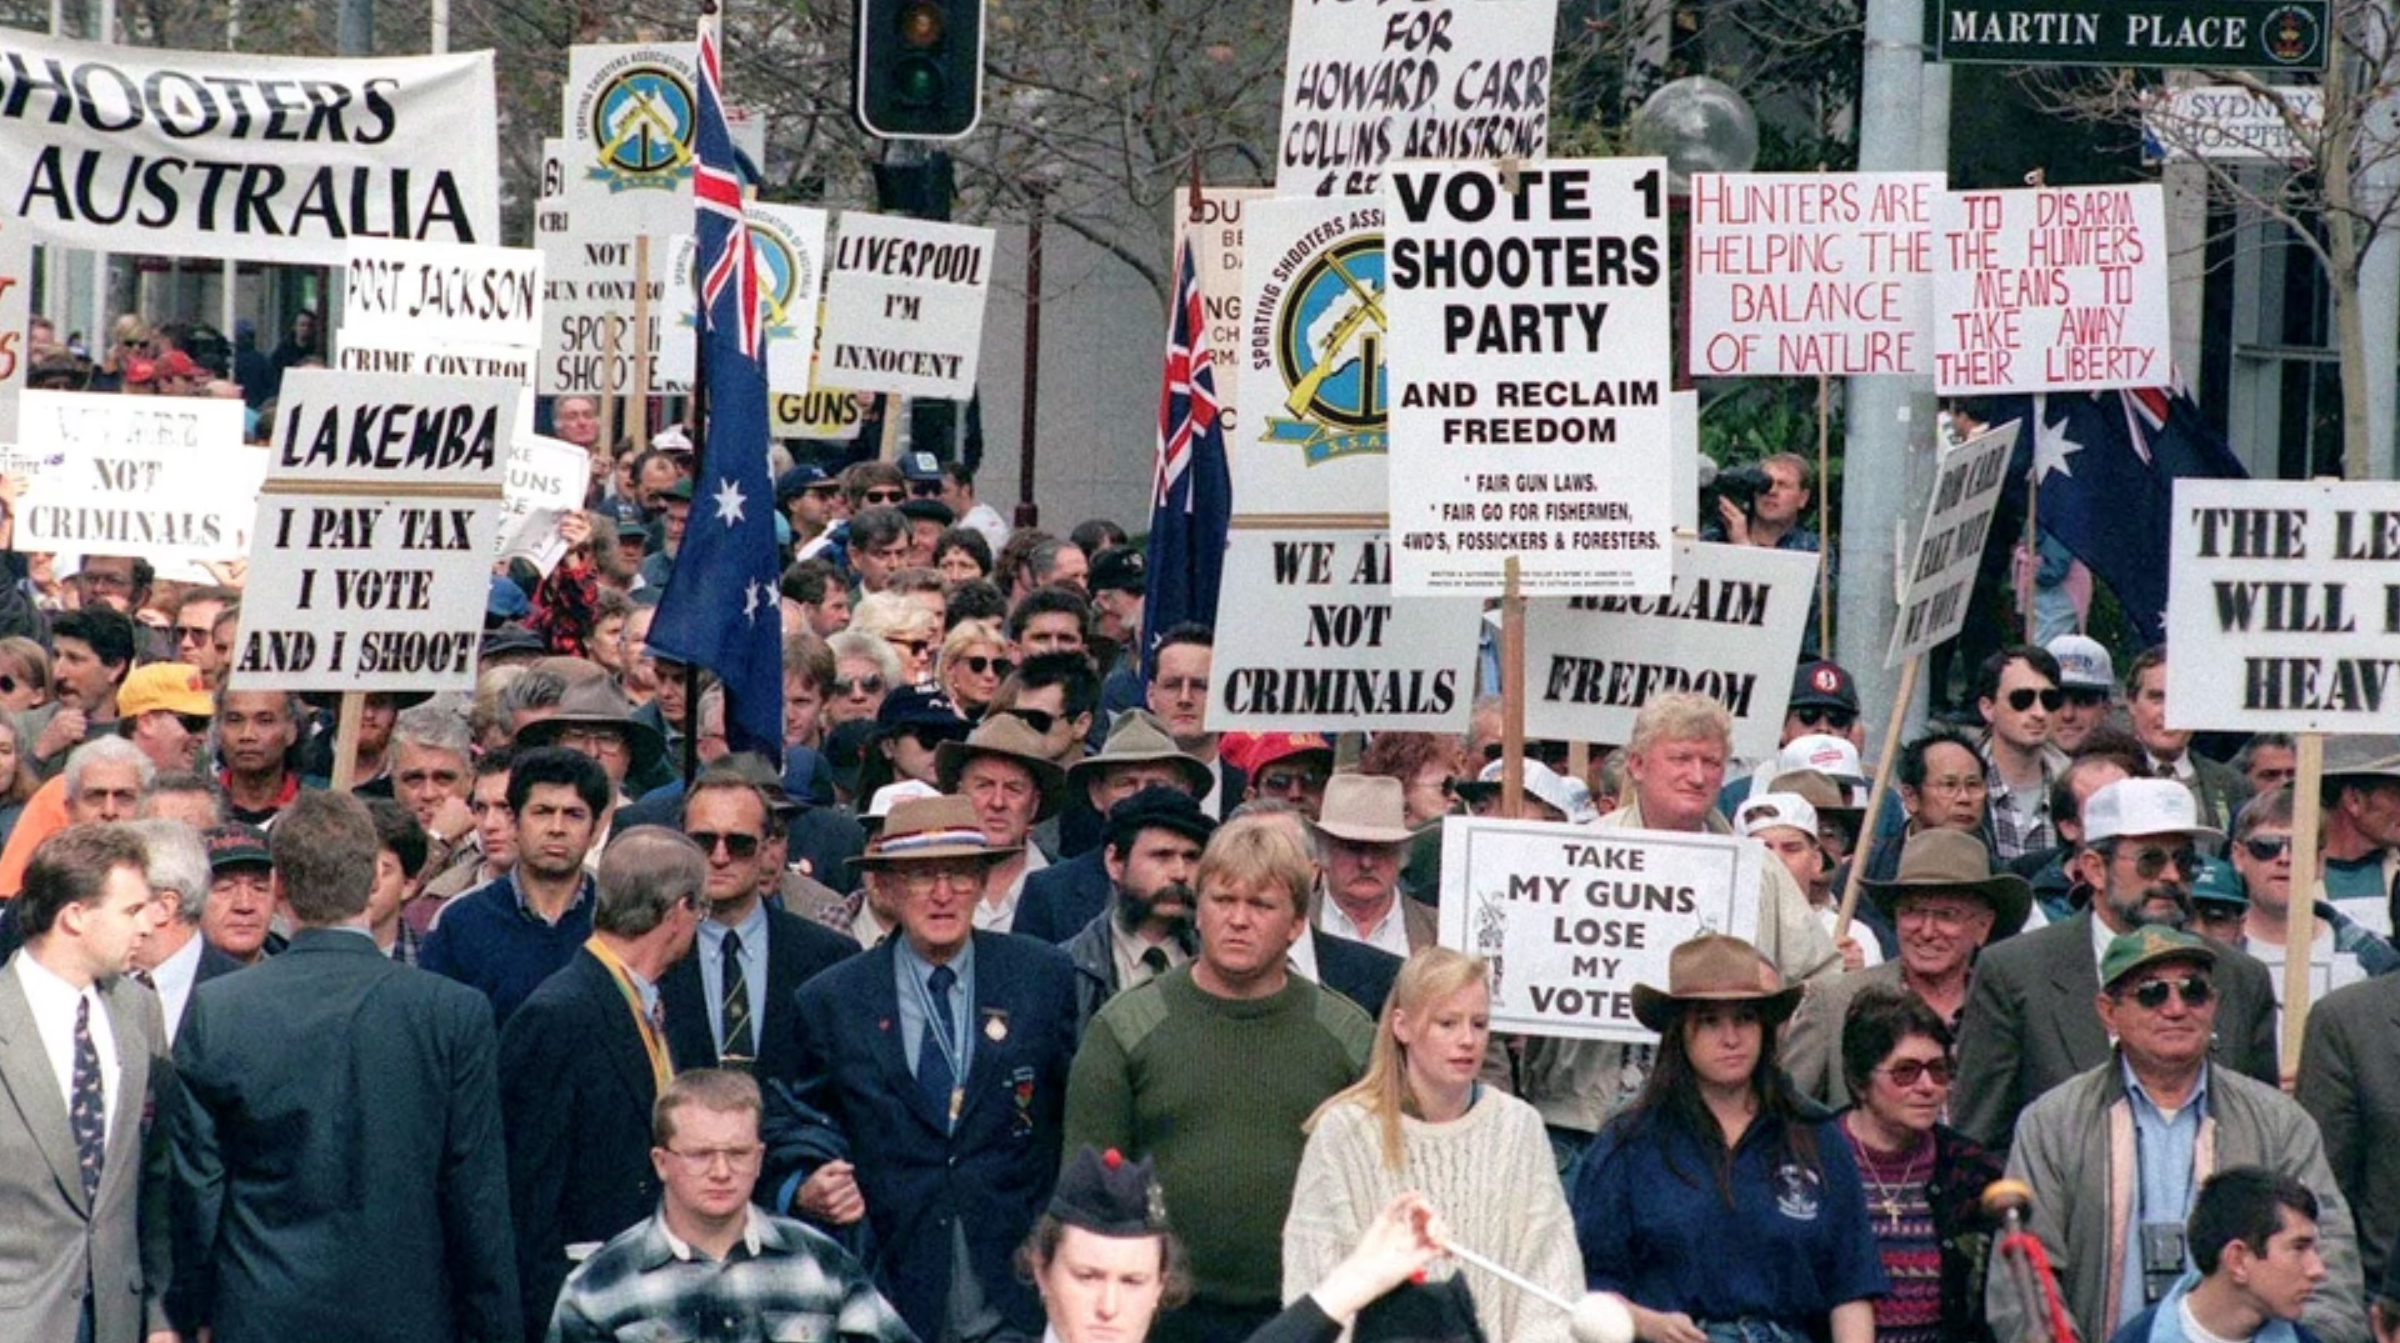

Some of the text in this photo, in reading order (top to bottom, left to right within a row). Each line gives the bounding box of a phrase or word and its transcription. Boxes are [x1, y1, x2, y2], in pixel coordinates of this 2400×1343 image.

[1383, 9, 1453, 52] FOR
[1950, 10, 2247, 48] MARTIN PLACE
[0, 53, 400, 144] HOOTERS
[1454, 56, 1547, 111] CARR
[2191, 94, 2314, 118] SYDNY
[1285, 114, 1544, 168] COLLINS ARMSTRONG
[18, 146, 476, 244] AUSTRALIA
[1392, 171, 1592, 223] VOTE
[1633, 170, 1660, 219] 1
[1697, 175, 1930, 225] HUNTERS ARE
[1963, 191, 2135, 230] TO DISARM
[585, 243, 629, 266] NOT
[837, 236, 983, 286] LIVERPOOL
[1392, 235, 1660, 289] SHOOTERS
[1697, 231, 1933, 274] HELPING THE
[1945, 227, 2144, 271] THE HUNTERS
[349, 258, 540, 322] PORT JACKSON
[884, 294, 921, 320] I'M
[1251, 283, 1281, 371] SPORTING
[1274, 216, 1347, 281] SHOOTERS
[1731, 281, 1902, 322] BALANCE
[1974, 266, 2133, 310] MEANS TO
[1444, 303, 1608, 353] PARTY
[1952, 306, 2125, 350] TAKE AWAY
[834, 344, 963, 380] INNOCENT
[1707, 331, 1915, 373] OF NATURE
[1936, 346, 2155, 386] THEIR LIBERTY
[778, 391, 859, 425] GUNS
[1401, 381, 1659, 408] AND RECLAIM
[1443, 418, 1616, 444] FREEDOM
[92, 458, 163, 493] NOT
[1477, 474, 1598, 492] FAIR GUN LAWS.
[29, 505, 222, 547] CRIMINALS
[275, 508, 295, 549] I
[307, 508, 382, 550] PAY
[400, 509, 475, 551] TAX
[1443, 502, 1633, 523] FAIR GO FOR FISHERMEN,
[2192, 508, 2307, 559] THE
[1457, 532, 1548, 550] FOSSICKERS
[1555, 532, 1566, 550] &
[1572, 531, 1660, 550] FORESTERS.
[1273, 541, 1335, 585] WE
[297, 569, 434, 610] I VOTE
[2212, 581, 2355, 633] WILL
[1304, 604, 1391, 647] NOT
[237, 631, 475, 673] AND I SHOOT
[1224, 668, 1456, 716] CRIMINALS
[1562, 844, 1645, 872] TAKE
[1508, 874, 1696, 913] MY GUNS
[1554, 917, 1646, 949] LOSE
[1572, 956, 1621, 979] MY
[1529, 986, 1632, 1019] VOTE
